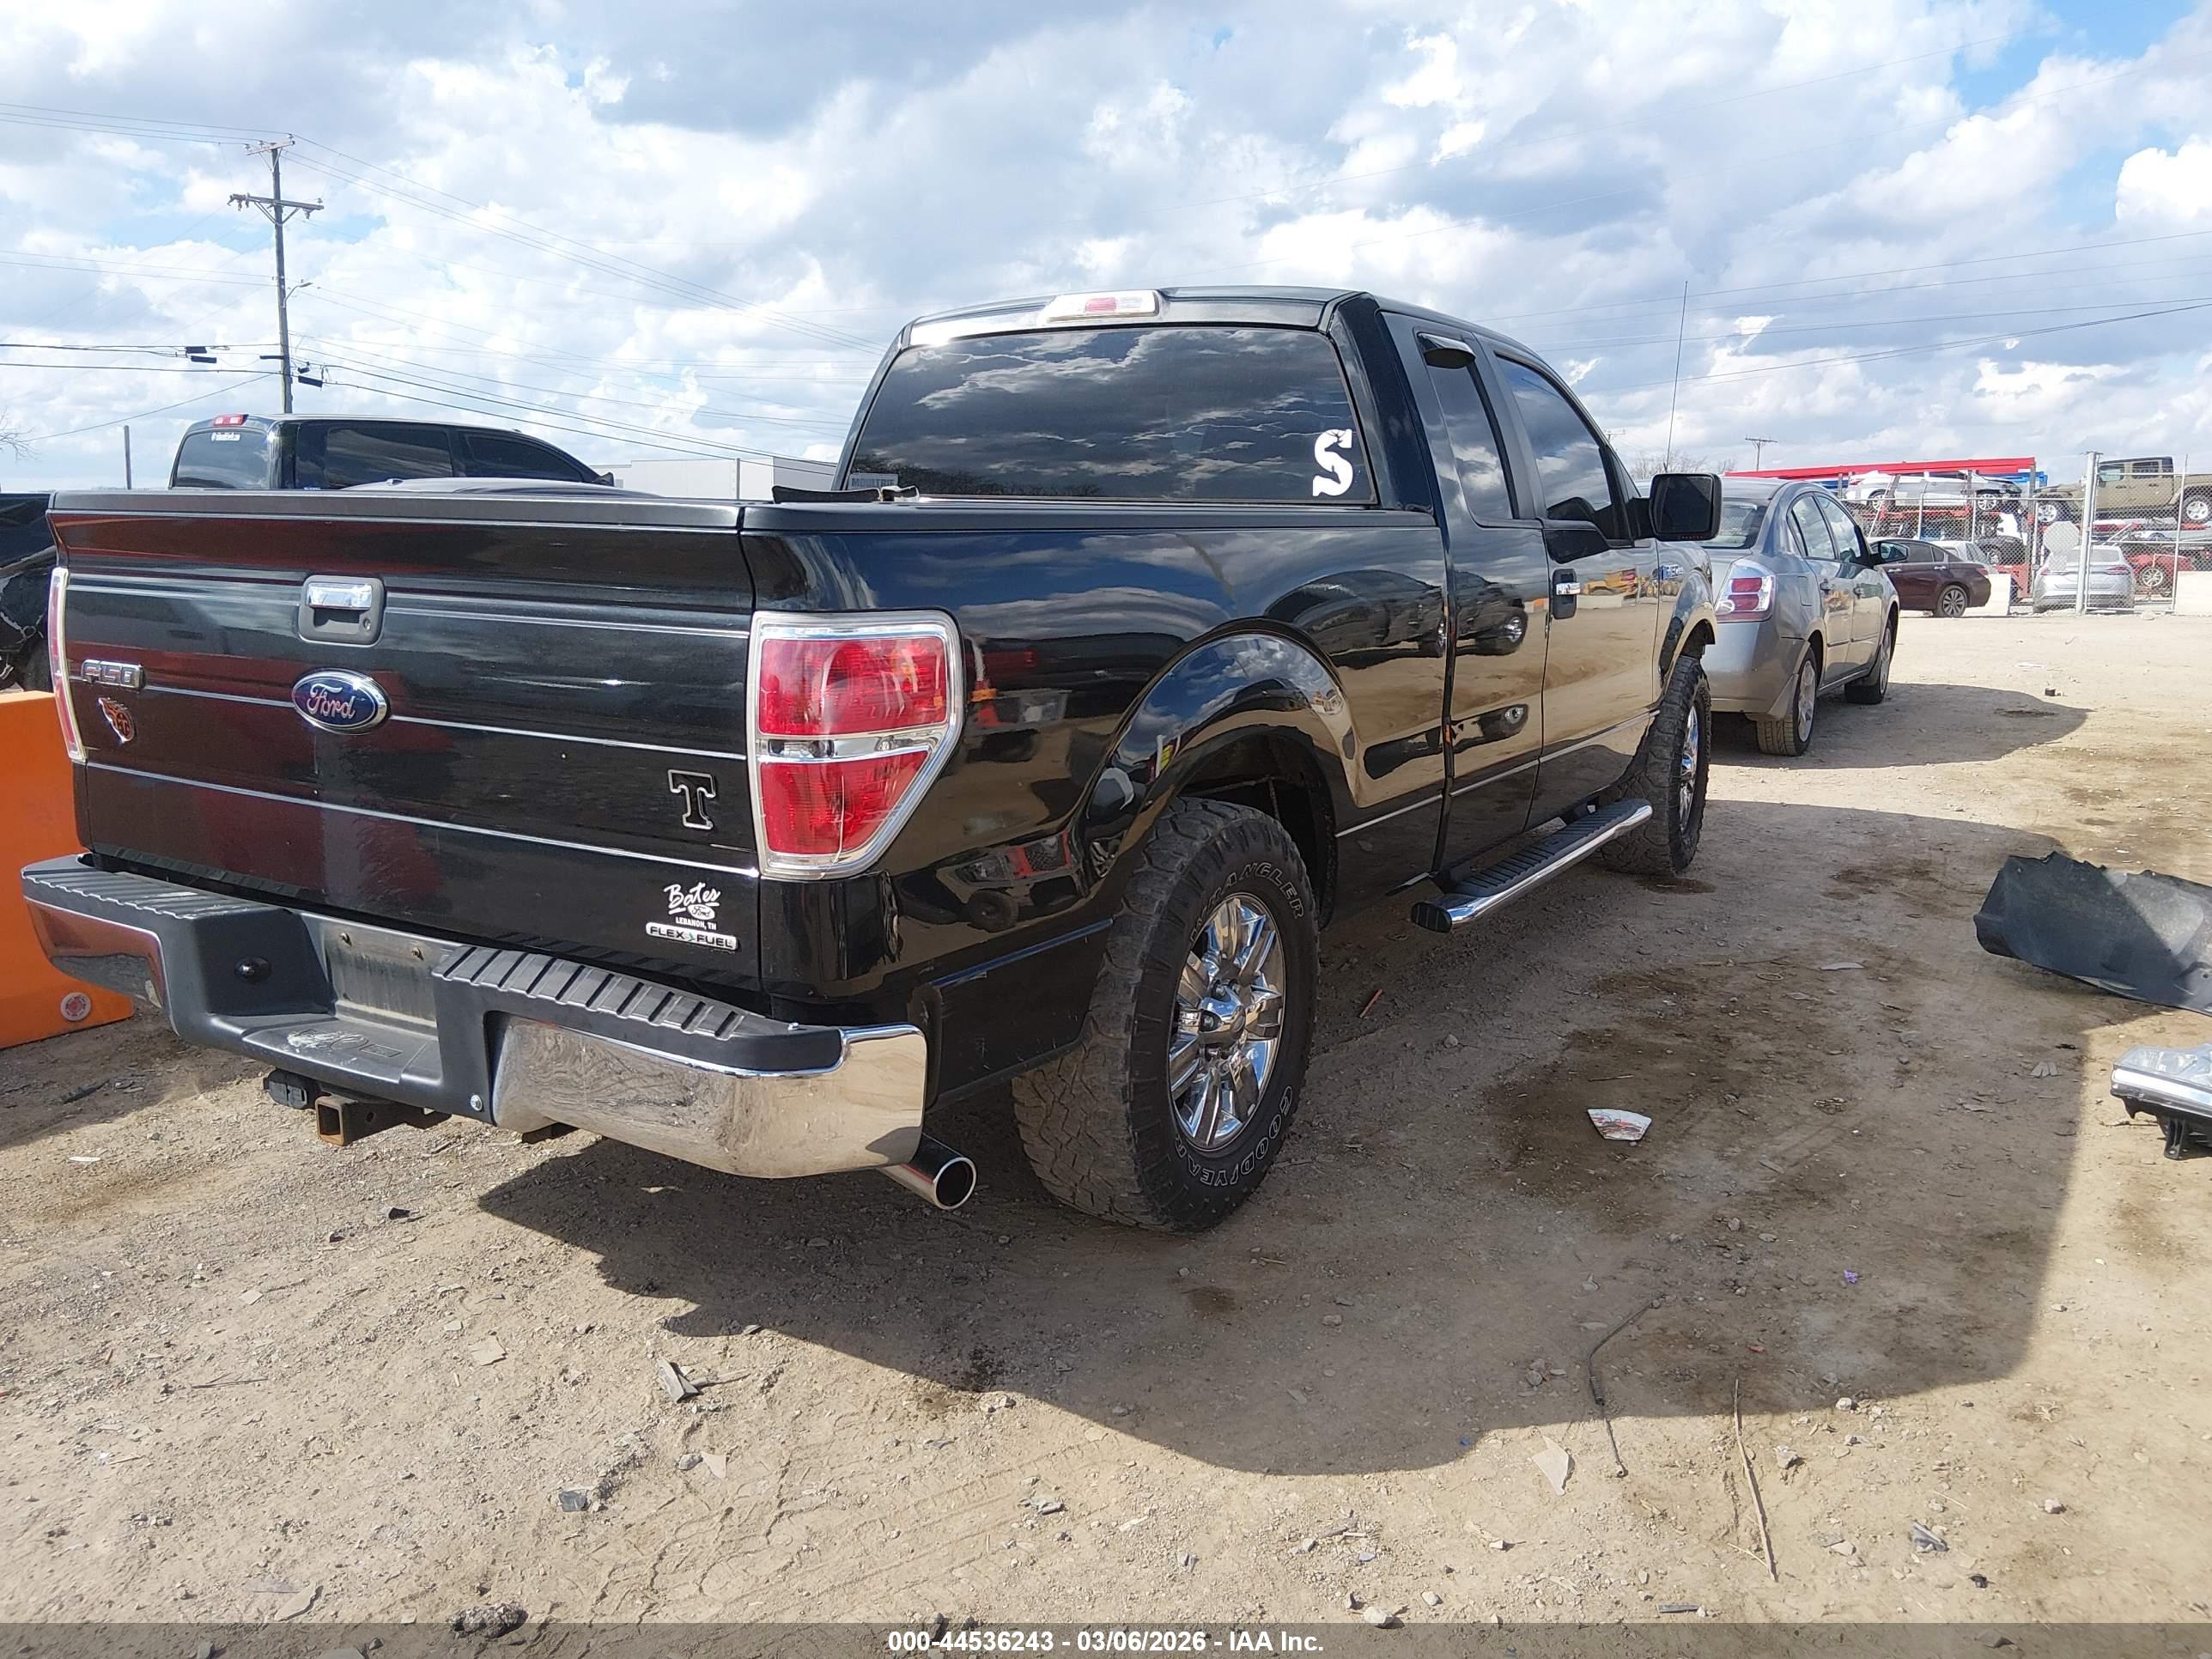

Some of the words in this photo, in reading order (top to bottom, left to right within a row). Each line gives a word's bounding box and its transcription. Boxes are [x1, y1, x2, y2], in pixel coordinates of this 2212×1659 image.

[1312, 428, 1352, 496] S
[307, 684, 356, 720] Ford
[668, 769, 716, 830] T
[663, 882, 720, 909] Bates
[691, 905, 711, 918] Ford
[650, 926, 684, 940] FLEX
[696, 933, 733, 948] FUEL
[1175, 1085, 1292, 1187] GOODYEAR
